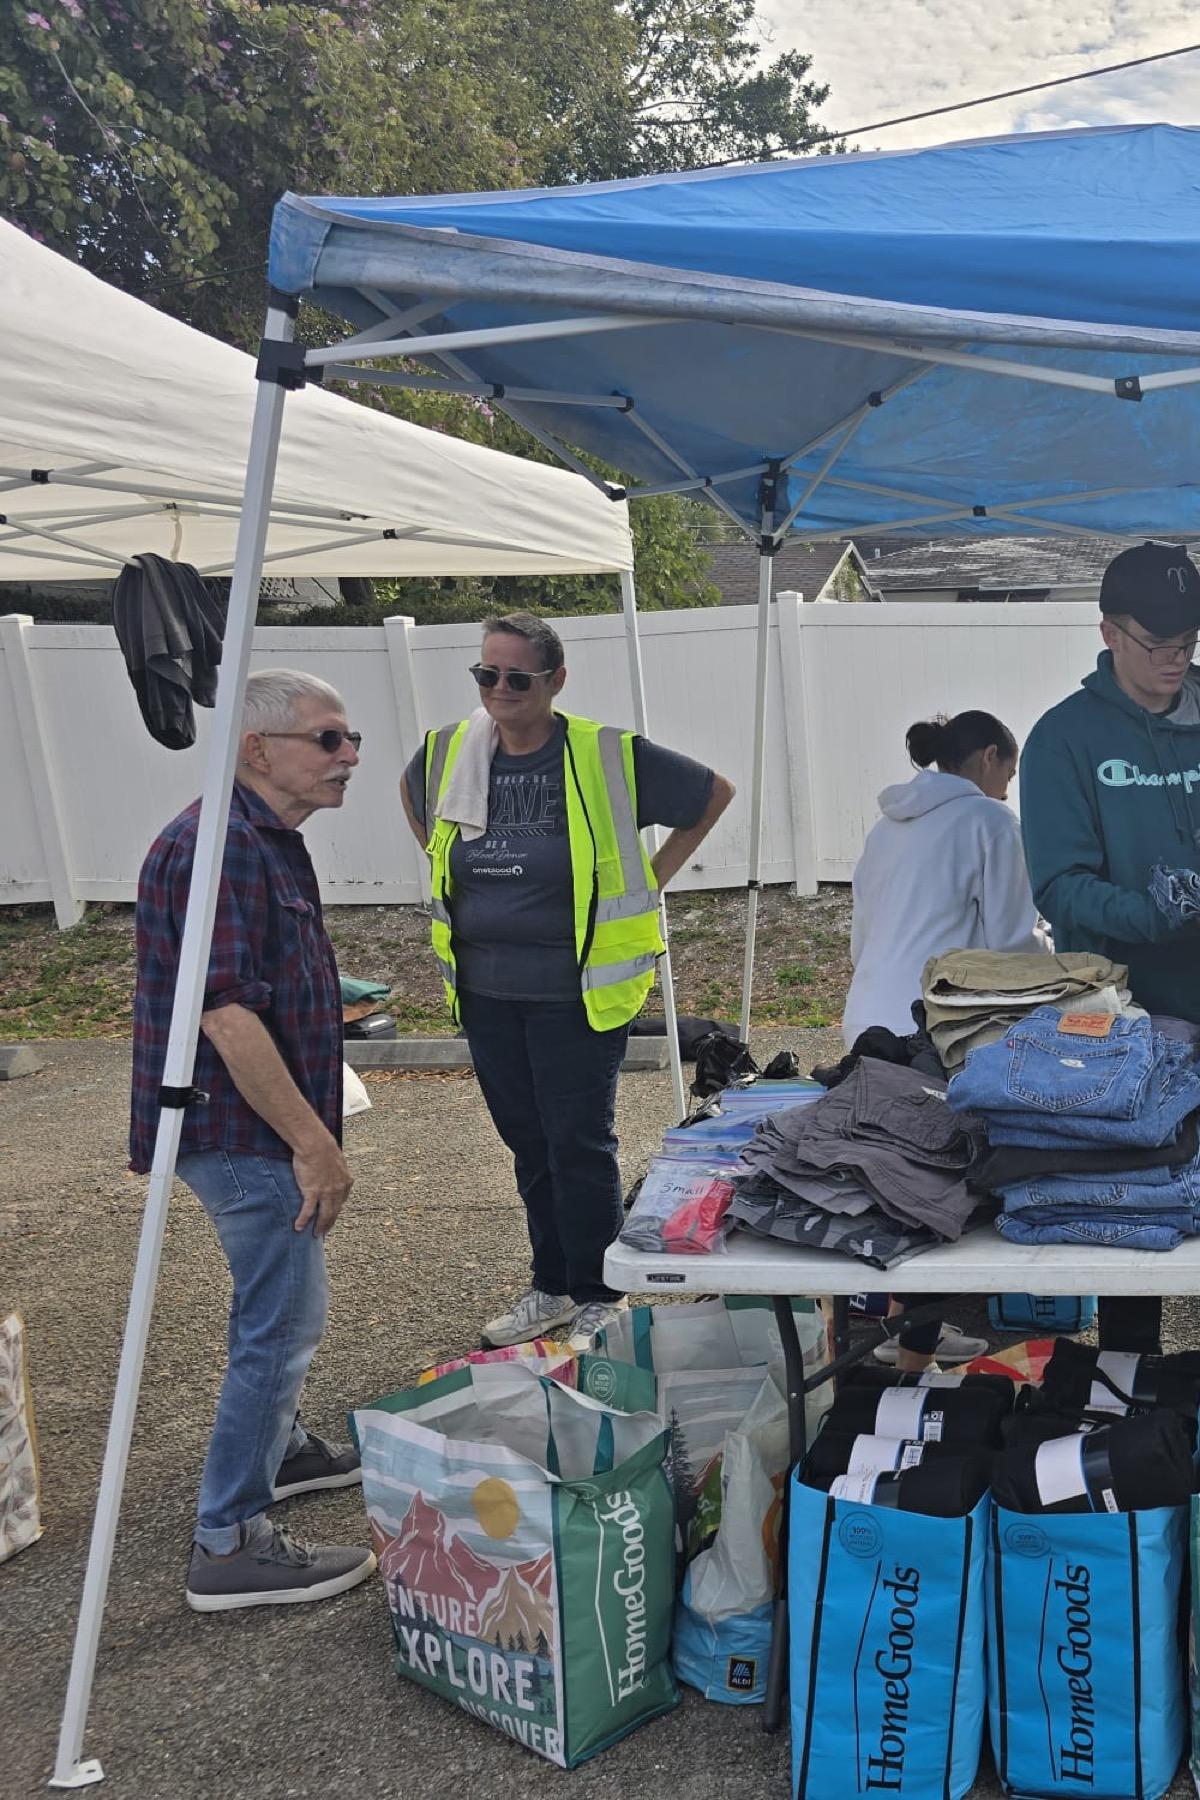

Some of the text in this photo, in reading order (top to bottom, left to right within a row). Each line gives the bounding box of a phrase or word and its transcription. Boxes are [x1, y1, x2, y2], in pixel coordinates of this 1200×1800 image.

[660, 1182, 704, 1195] Small
[600, 1490, 647, 1701] HomeGoods
[731, 1677, 752, 1687] ALDI
[866, 1566, 920, 1793] HomeGoods
[1055, 1564, 1095, 1786] HomeGoods
